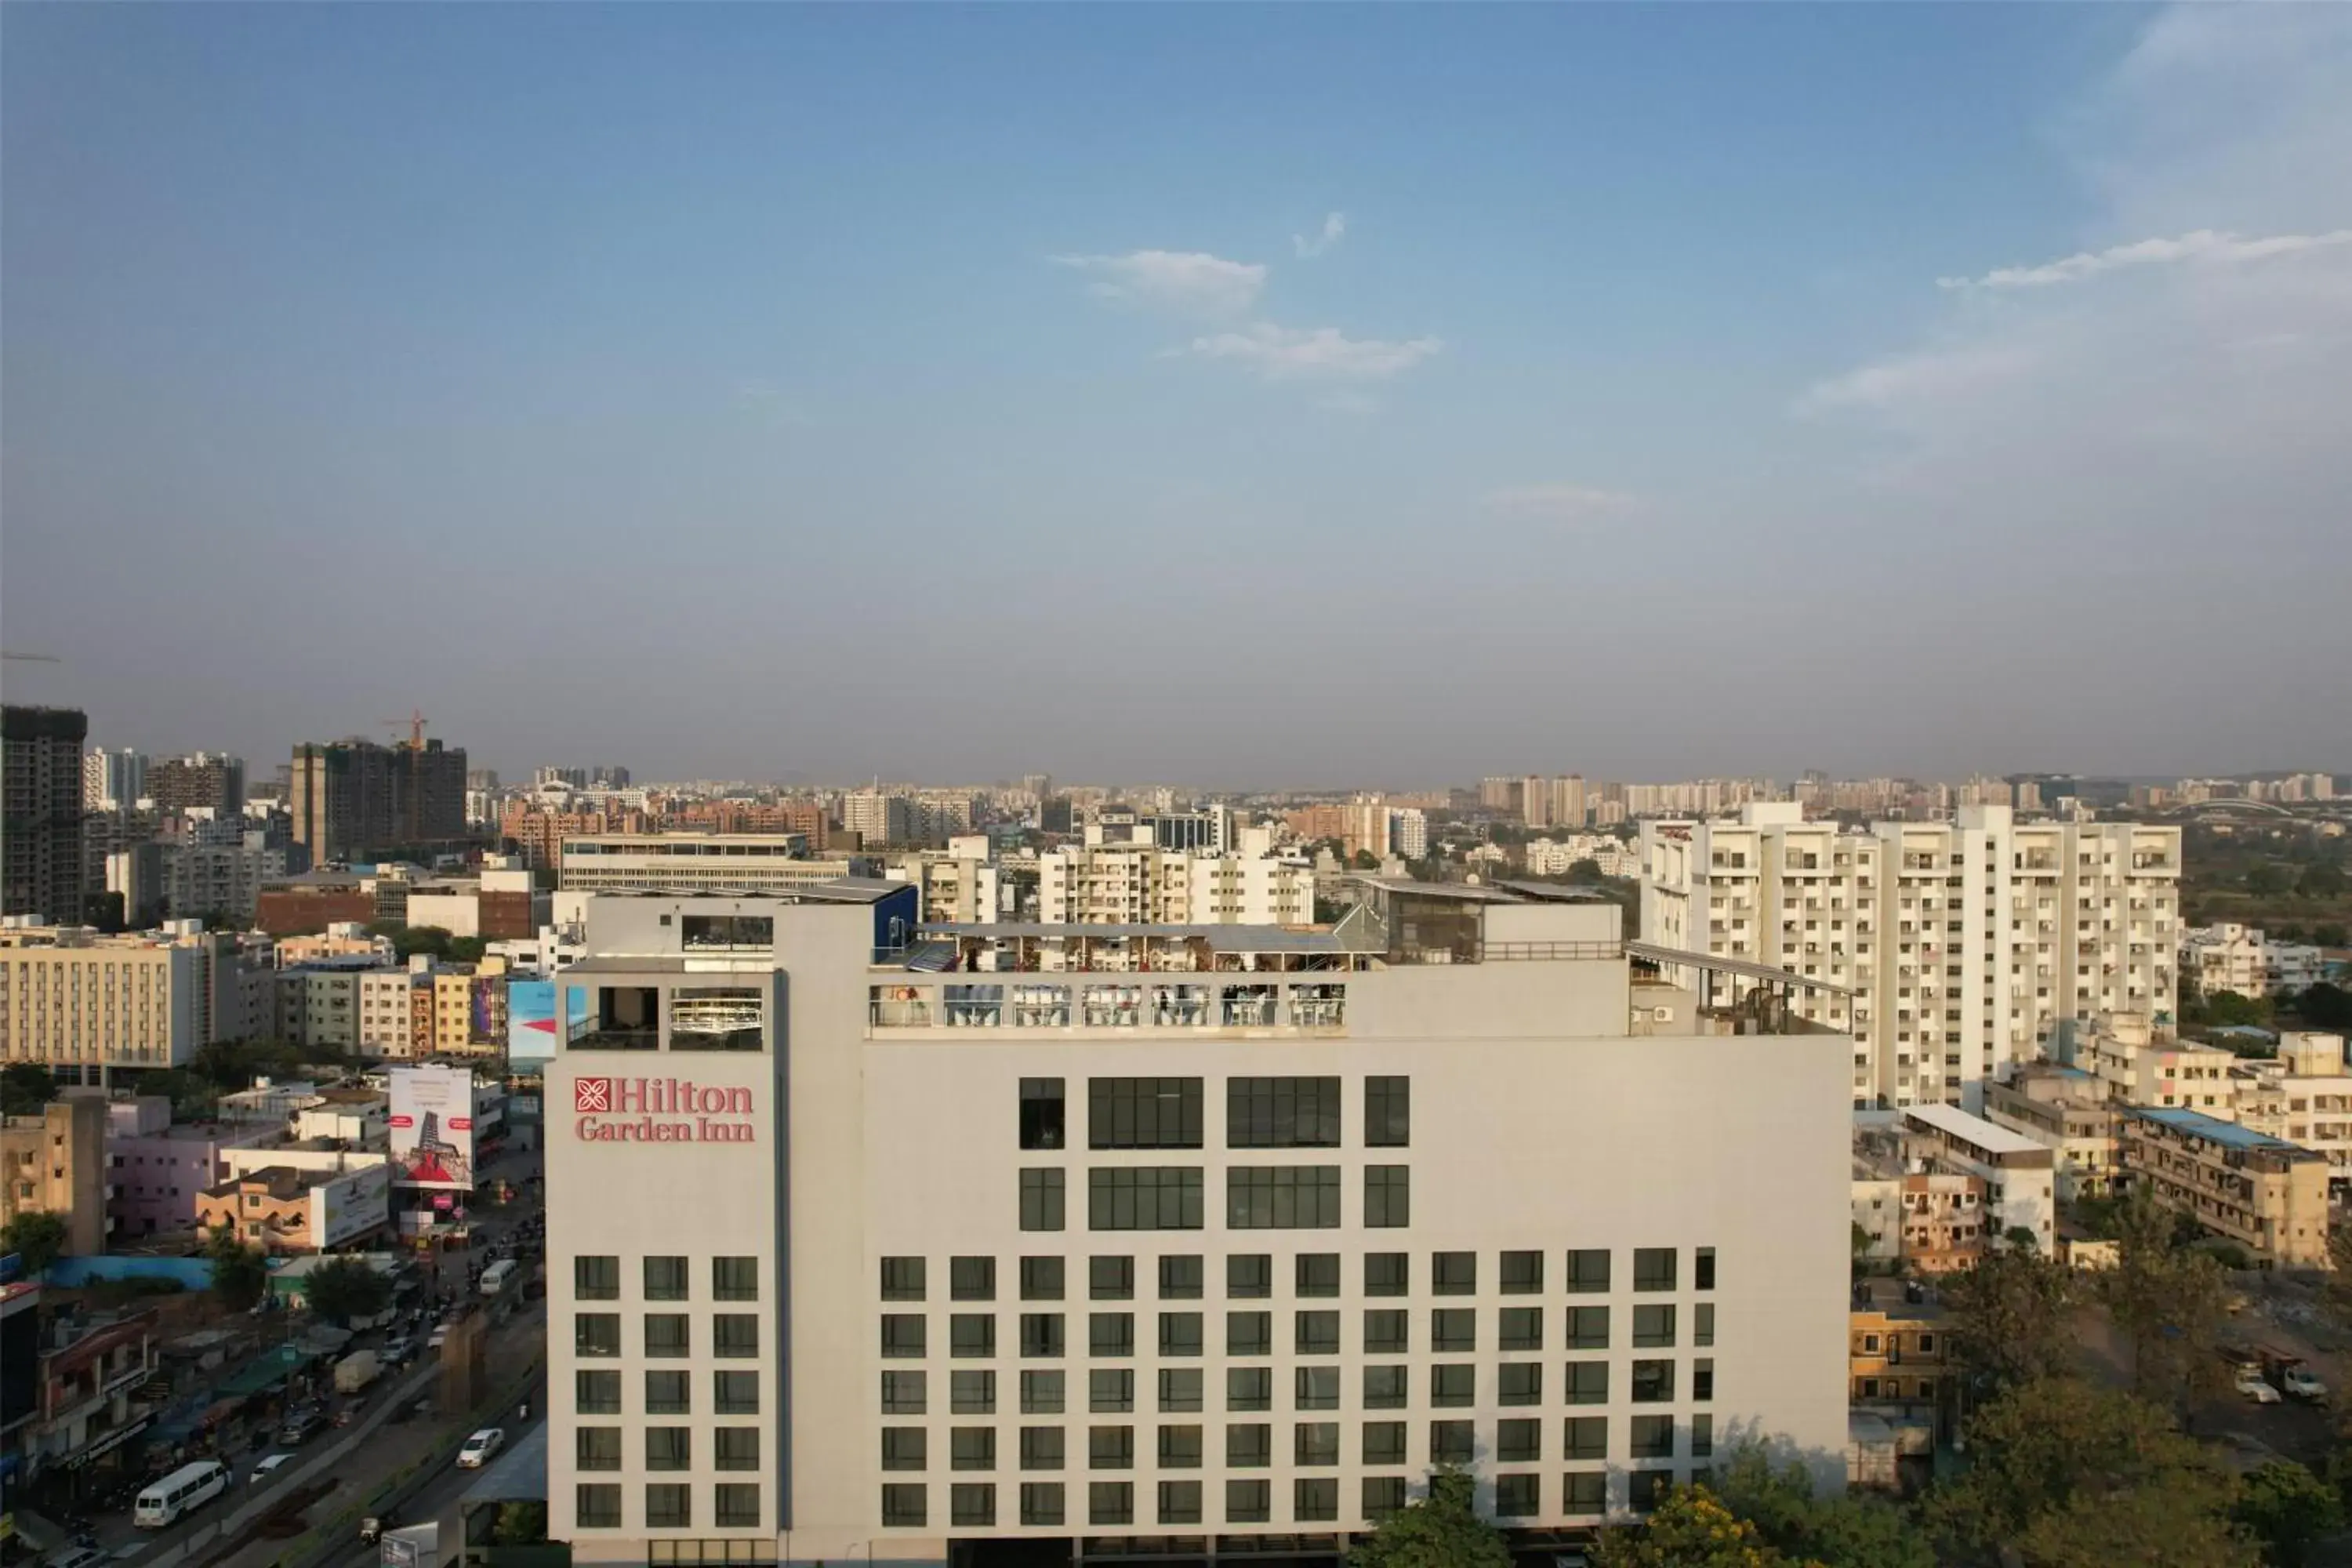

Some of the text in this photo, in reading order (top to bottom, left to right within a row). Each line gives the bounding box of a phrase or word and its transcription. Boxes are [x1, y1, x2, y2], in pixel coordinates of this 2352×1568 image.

[614, 1078, 753, 1113] Hilton
[576, 1116, 755, 1142] Garden Inn
